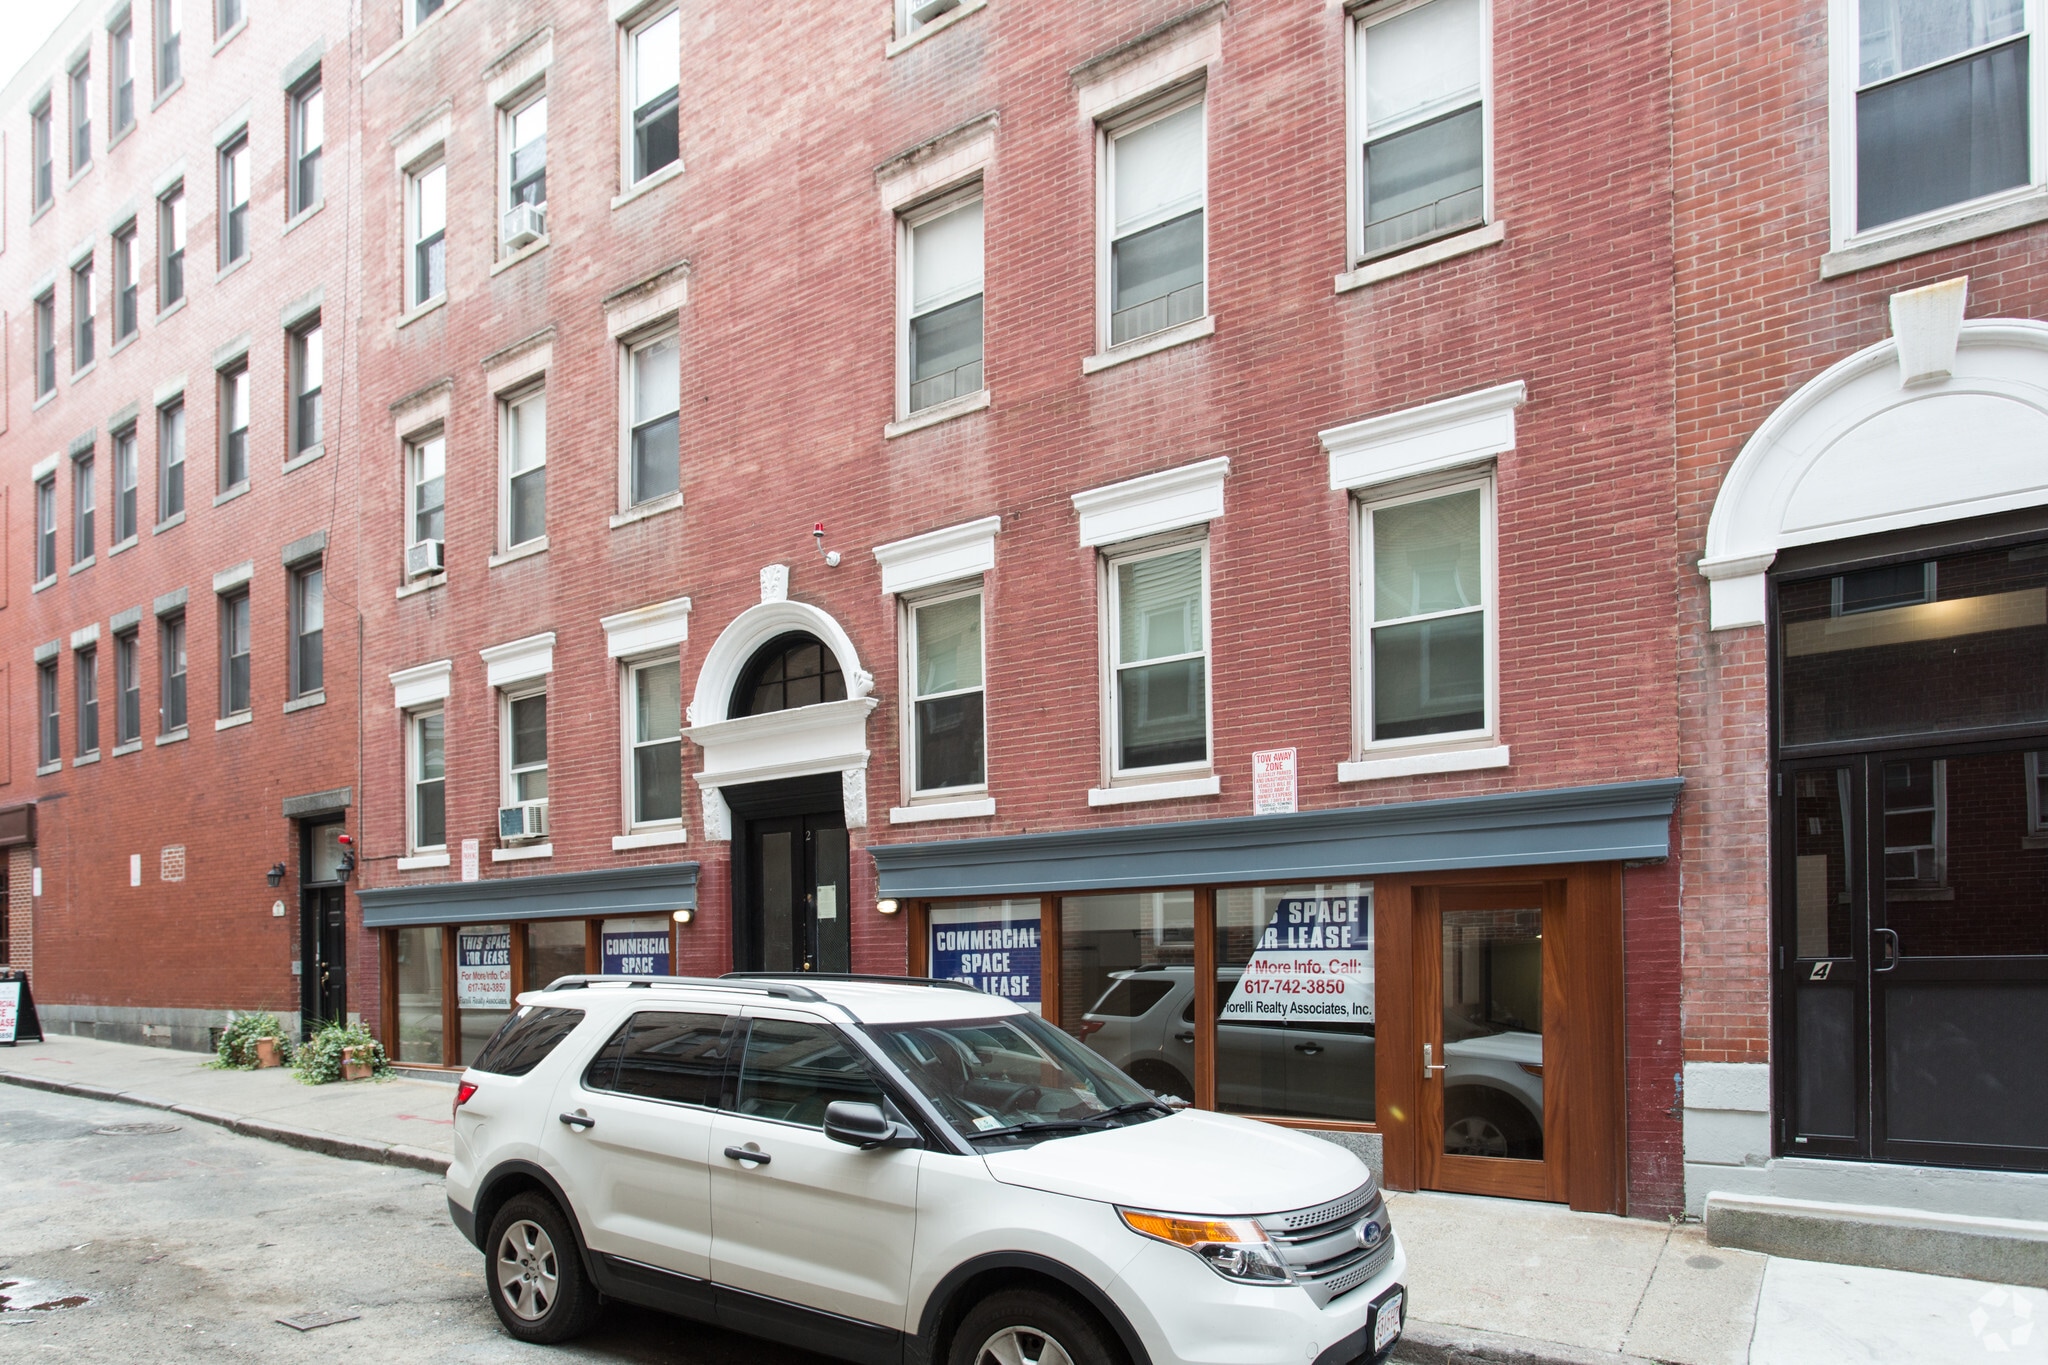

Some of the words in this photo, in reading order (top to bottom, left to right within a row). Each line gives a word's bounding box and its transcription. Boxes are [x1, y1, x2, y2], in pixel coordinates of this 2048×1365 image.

[1257, 754, 1271, 763] TOW
[1273, 752, 1291, 761] AWAY
[1266, 762, 1283, 771] ZONE
[805, 830, 811, 841] 2
[1289, 900, 1358, 923] SPACE
[463, 936, 483, 950] THIS
[486, 935, 510, 949] SPACE
[936, 928, 1037, 951] COMMERCIAL
[1288, 926, 1352, 949] LEASE
[606, 938, 670, 955] COMMERCIAL
[466, 951, 481, 965] FOR
[483, 951, 509, 964] LEASE
[622, 957, 653, 973] SPACE
[962, 953, 1010, 973] SPACE
[1255, 960, 1291, 974] More
[1295, 959, 1325, 974] Info.
[1329, 959, 1362, 974] Call:
[1813, 964, 1829, 978] 4
[461, 971, 472, 980] For
[473, 971, 486, 980] More
[468, 984, 506, 992] 617-742-3850
[982, 976, 1030, 996] LEASE
[1245, 979, 1345, 994] 617-742-3850
[1256, 1001, 1288, 1016] Realty
[1290, 1001, 1350, 1017] Associates,
[1352, 1002, 1372, 1015] Inc.
